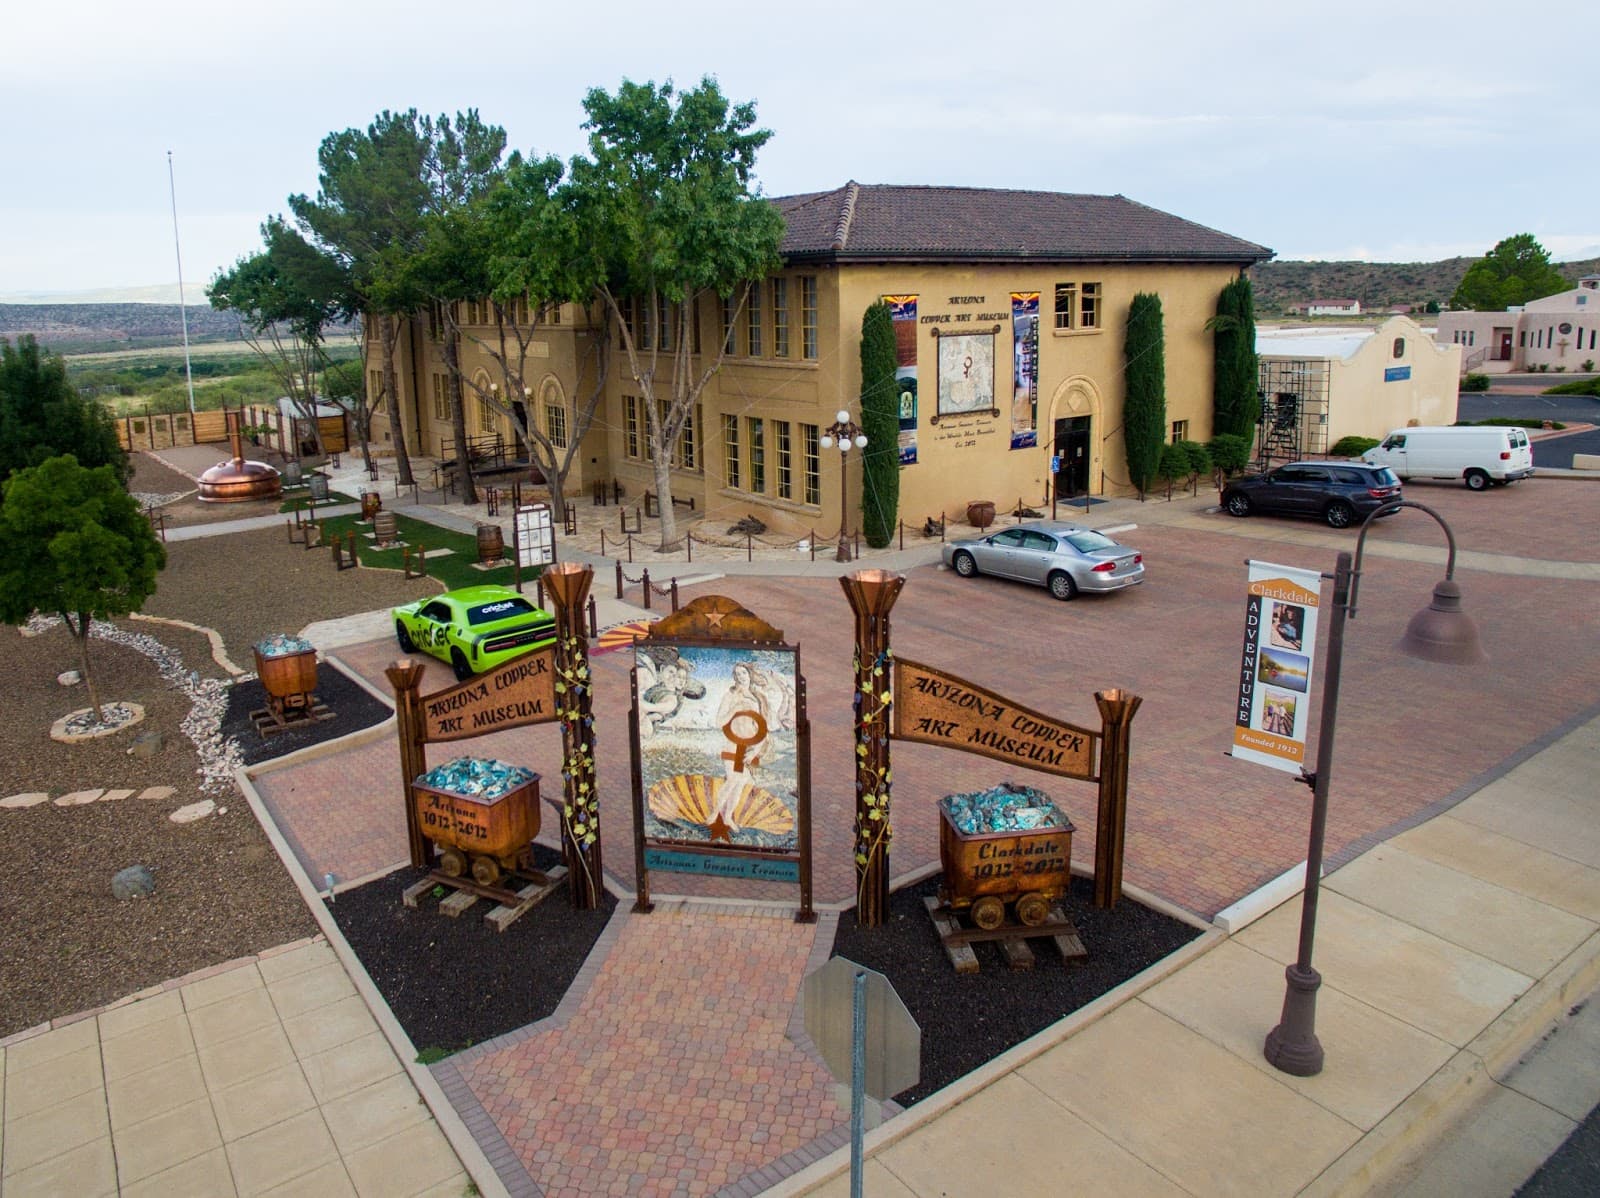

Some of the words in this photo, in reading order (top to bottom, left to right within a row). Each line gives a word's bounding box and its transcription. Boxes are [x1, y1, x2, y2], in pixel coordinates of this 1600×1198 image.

[948, 296, 985, 305] ARIZONA
[920, 314, 951, 324] COPPER
[954, 313, 972, 322] ART
[975, 312, 1010, 321] MUSEUM
[1251, 583, 1316, 605] Clarkdale
[482, 602, 515, 614] cricket
[1239, 601, 1258, 722] ADVENTURE
[428, 682, 490, 718] ARIZONA
[495, 657, 549, 690] COPPER
[438, 716, 464, 734] ART
[471, 699, 543, 729] MUSEUM
[910, 676, 1005, 722] ARIZONA
[1011, 715, 1084, 753] COPPER
[913, 717, 960, 738] ART
[968, 728, 1064, 766] MUSEUM
[1241, 734, 1275, 748] Founded
[1277, 743, 1298, 755] 1912
[428, 795, 477, 819] Arizona
[978, 840, 1059, 860] Clarkdale
